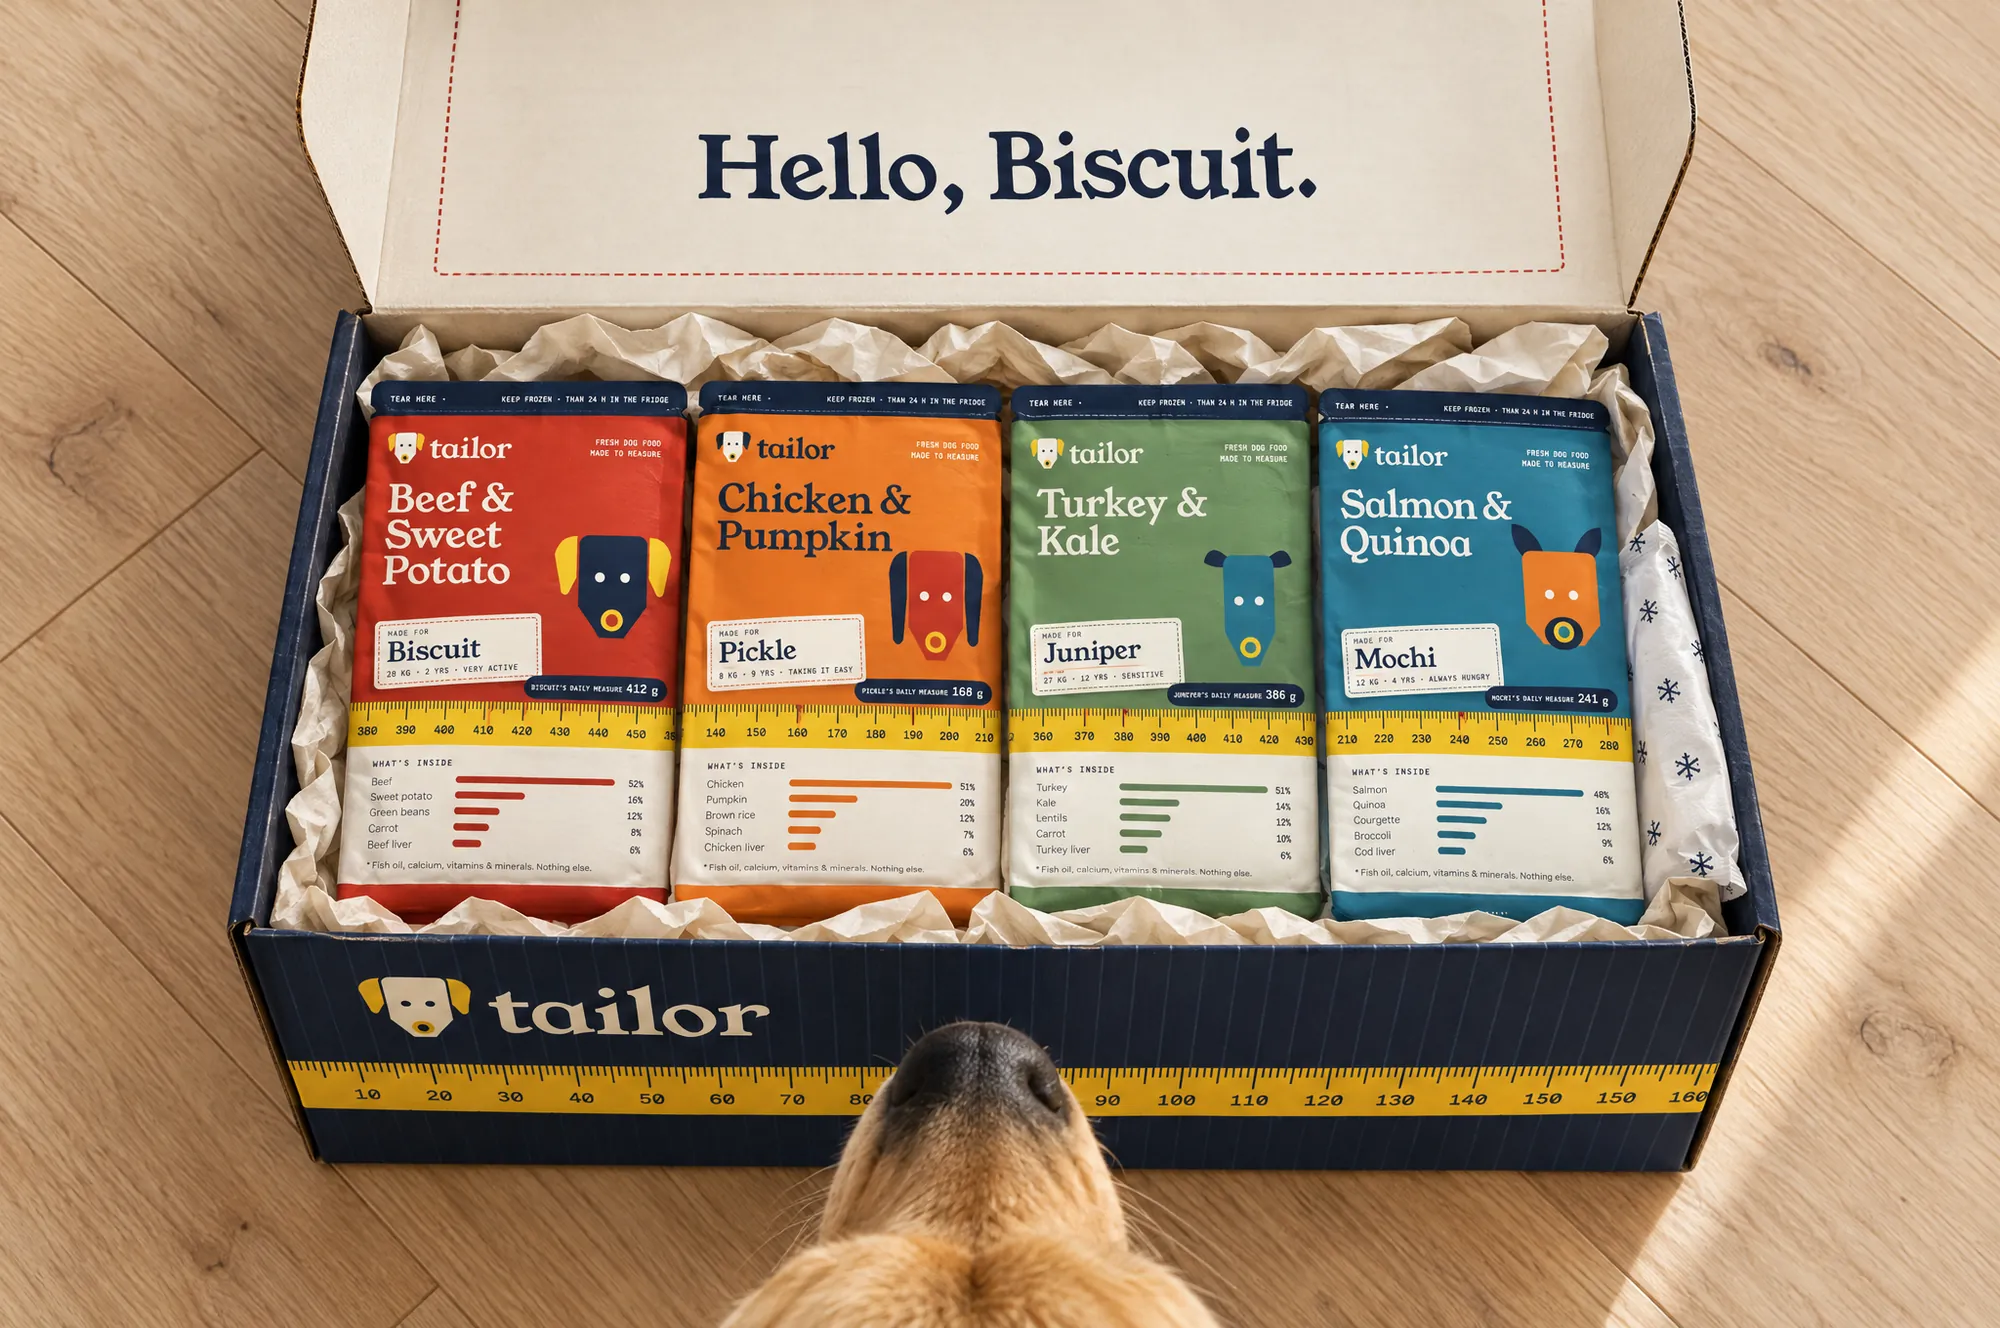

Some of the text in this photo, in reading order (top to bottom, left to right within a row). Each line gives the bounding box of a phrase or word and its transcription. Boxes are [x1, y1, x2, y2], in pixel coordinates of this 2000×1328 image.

[698, 127, 1316, 215] Hello, Biscuit.
[430, 436, 512, 458] tailor
[757, 437, 835, 460] tailor
[1069, 441, 1144, 464] tailor
[1374, 444, 1448, 466] tailor
[388, 481, 514, 512] Beef &
[718, 482, 911, 514] Chicken &
[1037, 486, 1207, 527] Turkey &
[1341, 488, 1512, 520] Salmon &
[385, 519, 502, 549] Sweet
[717, 520, 893, 558] Pumpkin
[1038, 524, 1119, 555] Kale
[1341, 526, 1472, 563] Quinoa
[383, 556, 510, 585] Potato
[387, 638, 481, 663] Biscuit
[720, 639, 796, 663] Pickle
[1044, 640, 1141, 665] Juniper
[1355, 646, 1436, 669] Mochi
[626, 684, 647, 694] 412
[953, 687, 972, 696] 168
[1266, 690, 1285, 699] 386
[1578, 693, 1598, 703] 241
[358, 725, 646, 739] 380 390 400 410 420 430 440 450
[707, 728, 994, 743] 140 150 160 170 180 190 200 210
[1034, 732, 1314, 745] 360 370 380 390 400 410 420 430
[1338, 734, 1619, 750] 210 220 230 240 250 260 270 280
[708, 762, 743, 770] WHAT'S
[372, 777, 392, 786] Beef
[629, 780, 644, 788] 52%
[707, 780, 743, 788] Chicken
[961, 783, 975, 791] 51%
[1037, 783, 1067, 793] Turkey
[1353, 786, 1387, 794] Salmon
[371, 791, 432, 802] Sweet potato
[1594, 791, 1609, 799] 48%
[628, 796, 643, 804] 16%
[707, 795, 747, 805] Pumpkin
[960, 799, 975, 807] 20%
[1037, 799, 1056, 807] Kale
[1276, 803, 1291, 811] 14%
[1353, 801, 1385, 810] Quinoa
[370, 808, 430, 817] Green beans
[706, 810, 755, 819] Brown rice
[1596, 807, 1610, 815] 16%
[628, 812, 642, 820] 12%
[960, 814, 974, 822] 12%
[1036, 814, 1067, 822] Lentils
[1277, 818, 1291, 826] 12%
[1354, 816, 1400, 826] Courgette
[368, 824, 398, 833] Carrot
[1597, 823, 1611, 831] 12%
[631, 828, 641, 836] 8%
[705, 827, 742, 837] Spinach
[964, 831, 974, 839] 7%
[1036, 829, 1065, 838] Carrot
[1355, 831, 1391, 840] Broccoli
[1277, 835, 1291, 843] 10%
[1602, 839, 1612, 847] 9%
[368, 840, 412, 849] Beef liver
[704, 843, 764, 852] Chicken liver
[630, 846, 640, 854] 6%
[963, 848, 974, 856] 6%
[1036, 845, 1090, 856] Turkey liver
[1355, 847, 1395, 856] Cod liver
[1281, 852, 1291, 860] 6%
[1603, 856, 1614, 864] 6%
[1381, 869, 1393, 877] oil,
[1395, 868, 1431, 878] calcium,
[1433, 869, 1469, 878] vitamins
[1471, 869, 1478, 877] &
[1478, 871, 1518, 879] minerals.
[1520, 872, 1552, 882] Nothing
[1555, 873, 1574, 881] else.
[488, 985, 771, 1039] tailor
[355, 1089, 875, 1106] 10 20 30 40 50 60 70 80
[1094, 1091, 1709, 1107] 90 100 110 120 130 140 150 150 160
